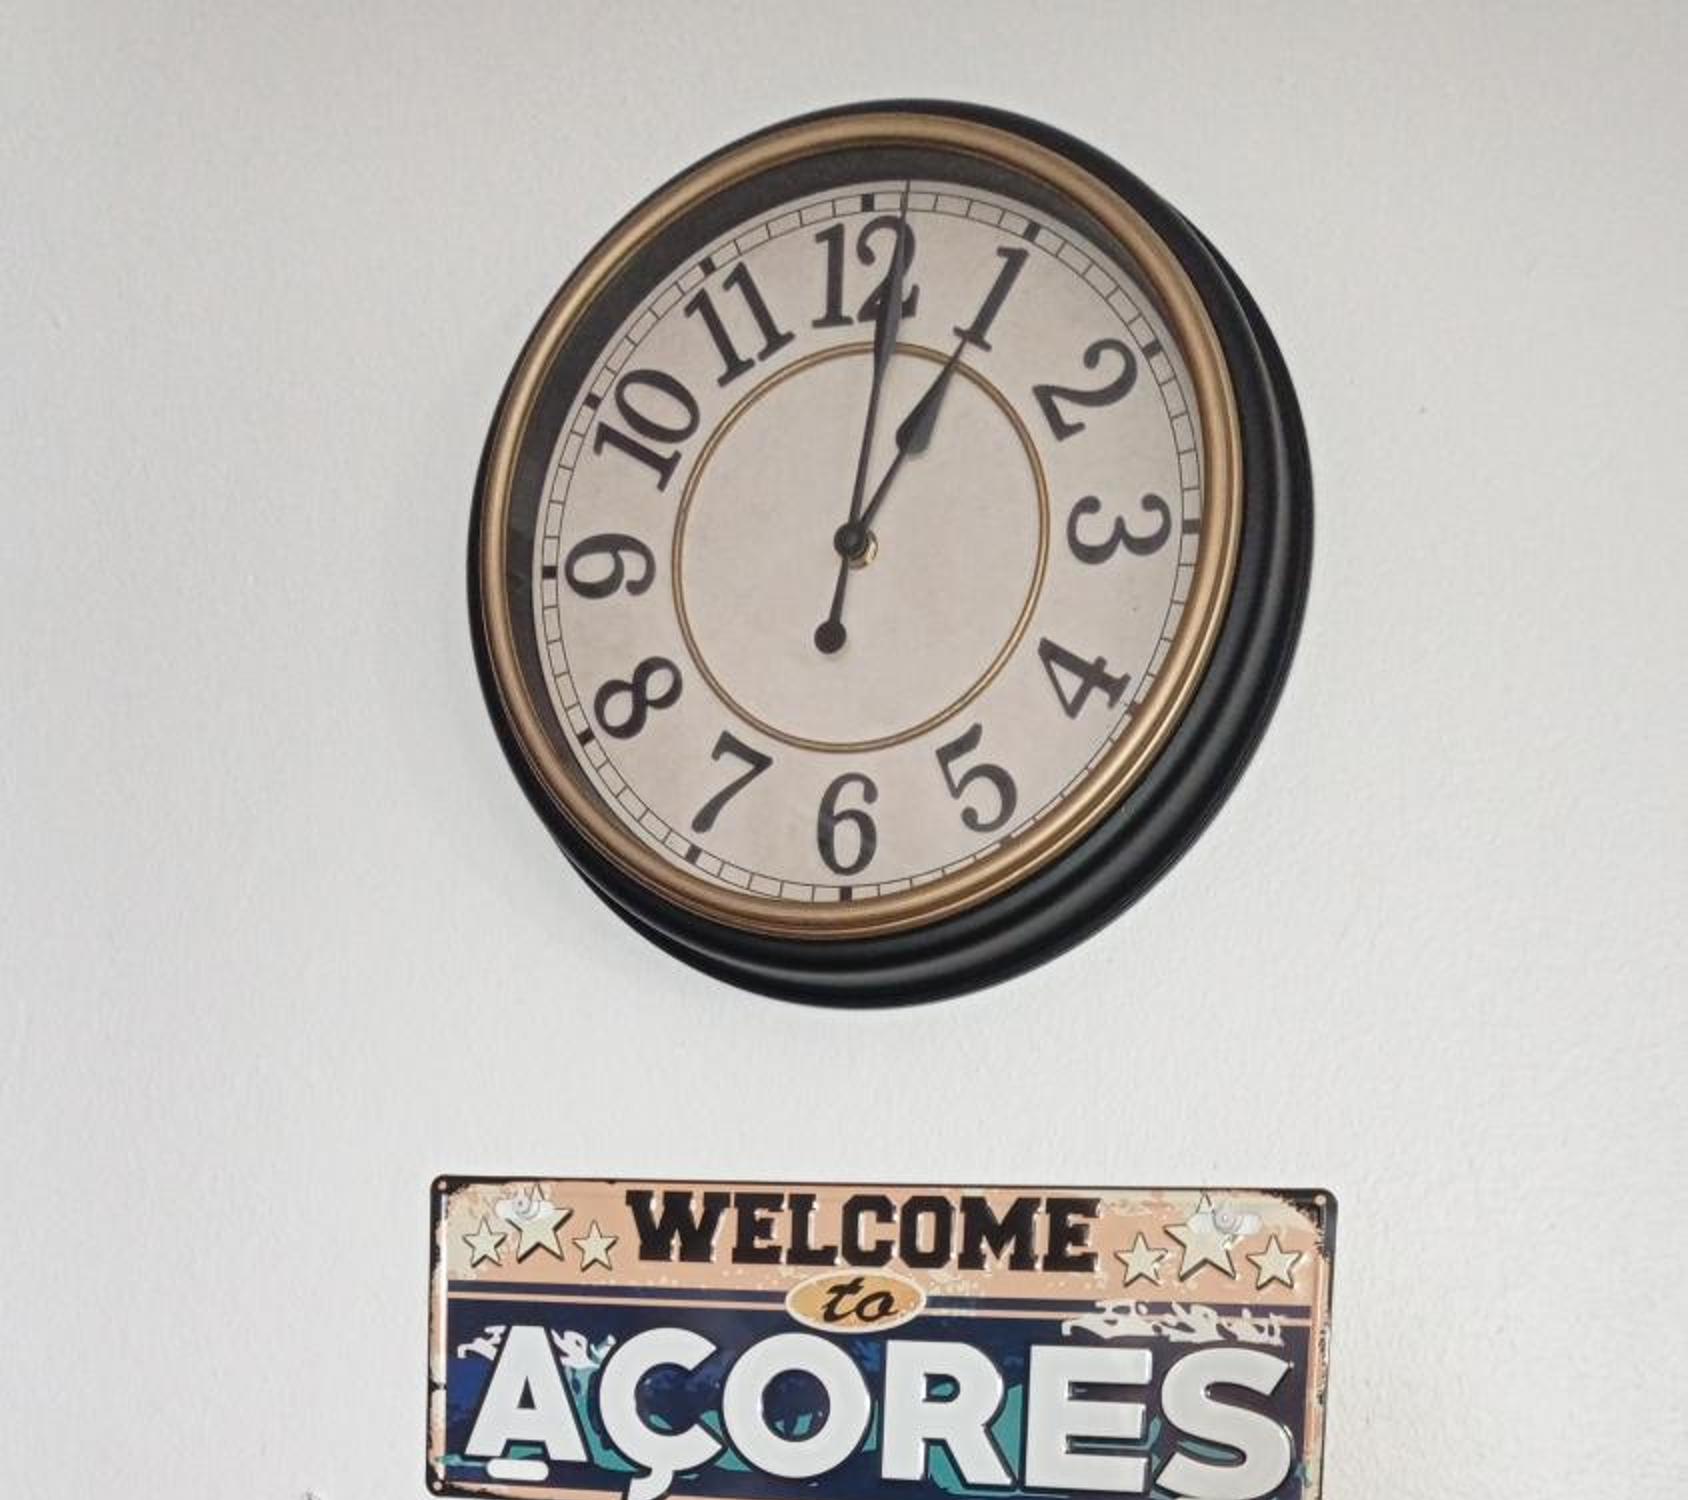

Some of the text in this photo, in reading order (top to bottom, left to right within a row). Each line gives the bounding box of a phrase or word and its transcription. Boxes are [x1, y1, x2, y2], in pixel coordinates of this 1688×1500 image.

[812, 214, 920, 329] 12
[955, 246, 1030, 353] 1
[683, 261, 796, 388] 11
[593, 368, 701, 492] 10
[1032, 337, 1138, 442] 2
[563, 532, 656, 601] 9
[1066, 493, 1173, 566] 3
[593, 655, 684, 741] 8
[1038, 637, 1132, 719] 4
[690, 730, 774, 834] 7
[816, 772, 878, 877] 6
[935, 723, 1018, 833] 5
[625, 1188, 1102, 1272] WELCOME
[821, 1276, 901, 1324] to
